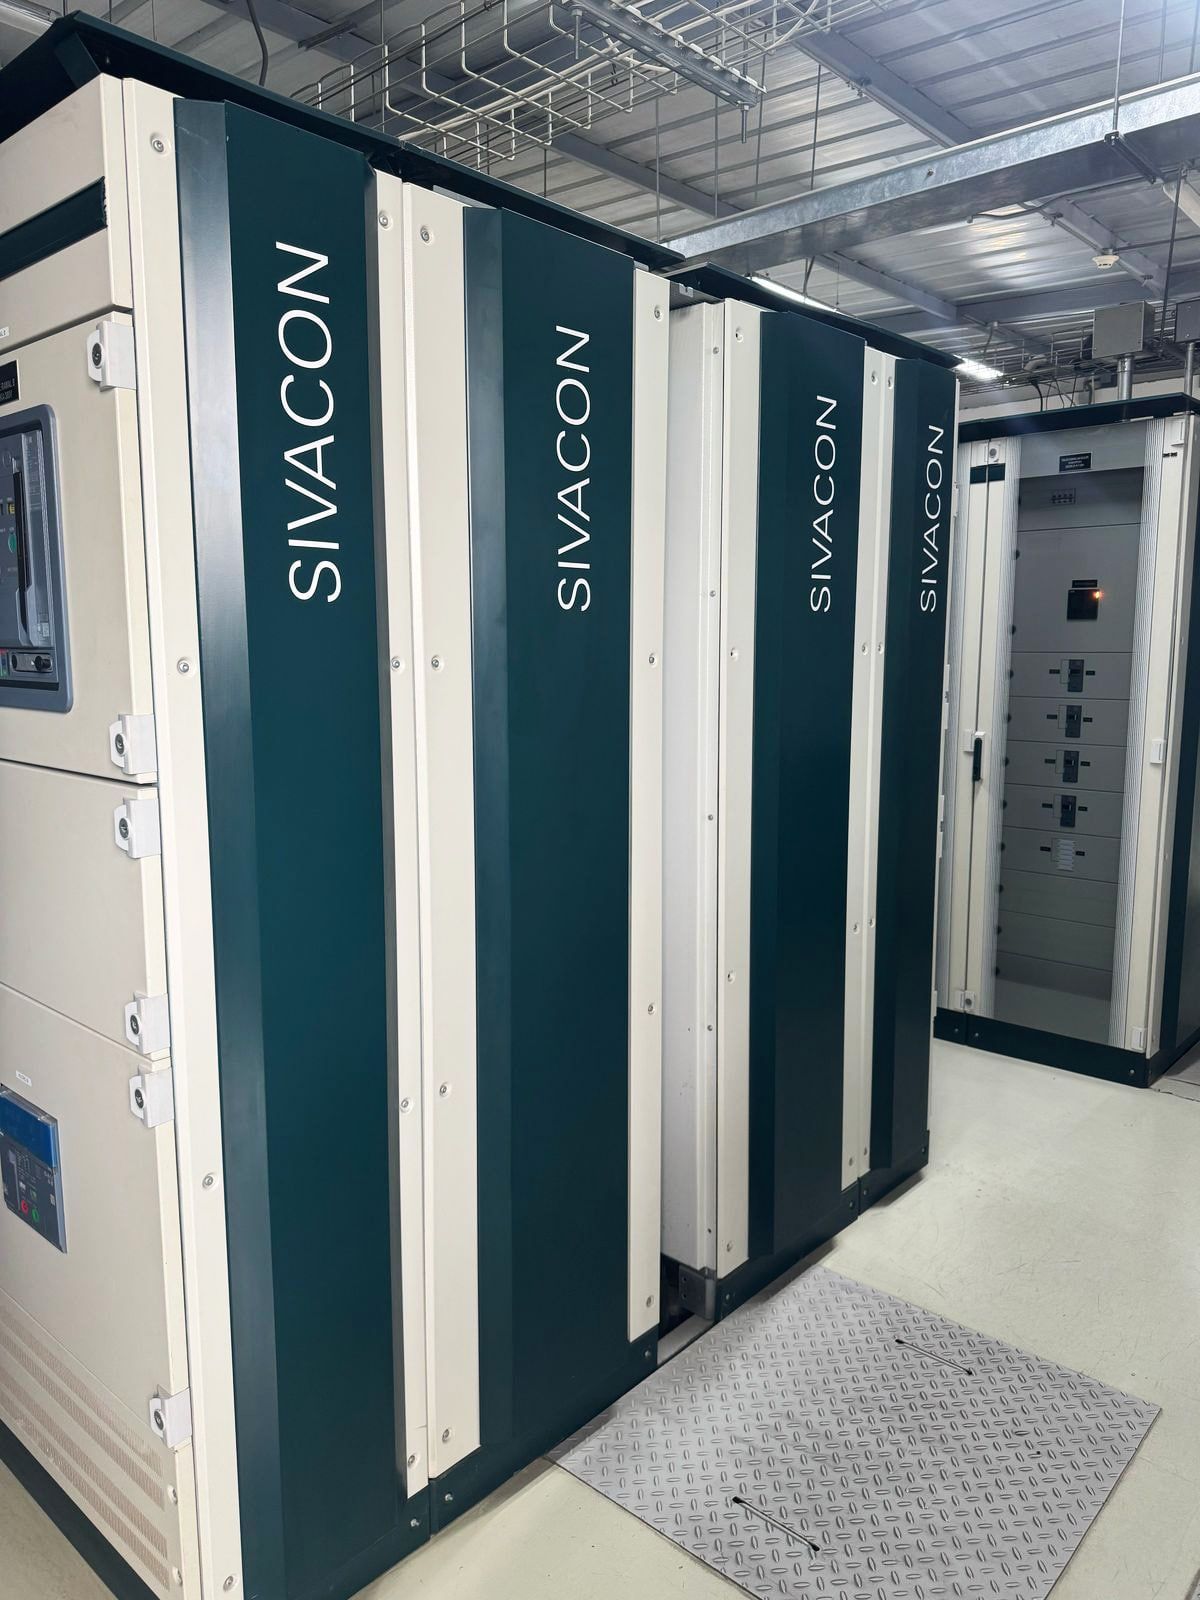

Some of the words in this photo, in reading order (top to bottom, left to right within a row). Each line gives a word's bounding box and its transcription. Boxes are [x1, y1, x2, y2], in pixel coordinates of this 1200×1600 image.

[276, 242, 342, 602] SIVACON
[556, 326, 591, 612] SIVACON
[810, 396, 837, 613] SIVACON
[920, 425, 945, 613] SIVACON
